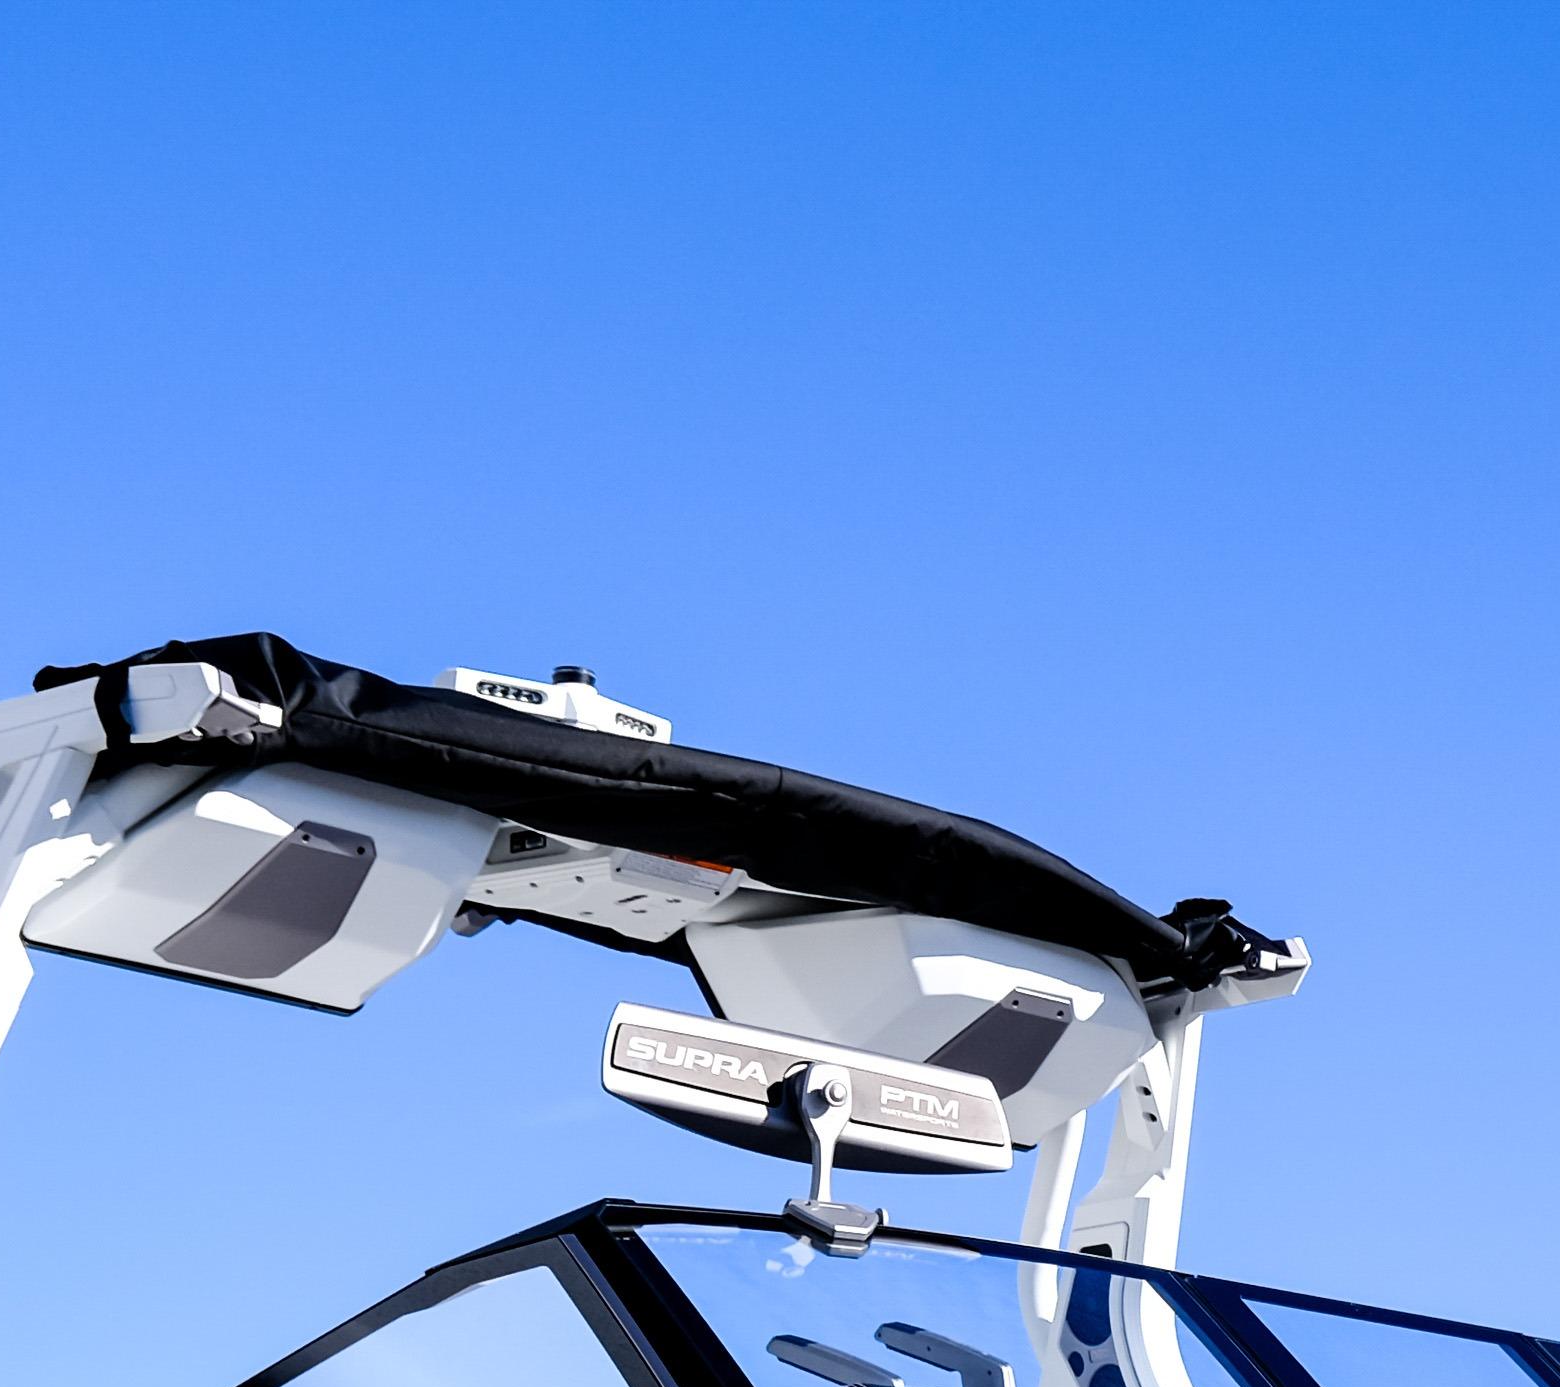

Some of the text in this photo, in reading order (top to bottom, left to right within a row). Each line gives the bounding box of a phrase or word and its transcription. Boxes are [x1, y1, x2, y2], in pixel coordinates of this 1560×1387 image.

[626, 1035, 770, 1087] SUPRA
[879, 1106, 960, 1130] WATERSPORTS
[880, 1083, 960, 1121] PTM
